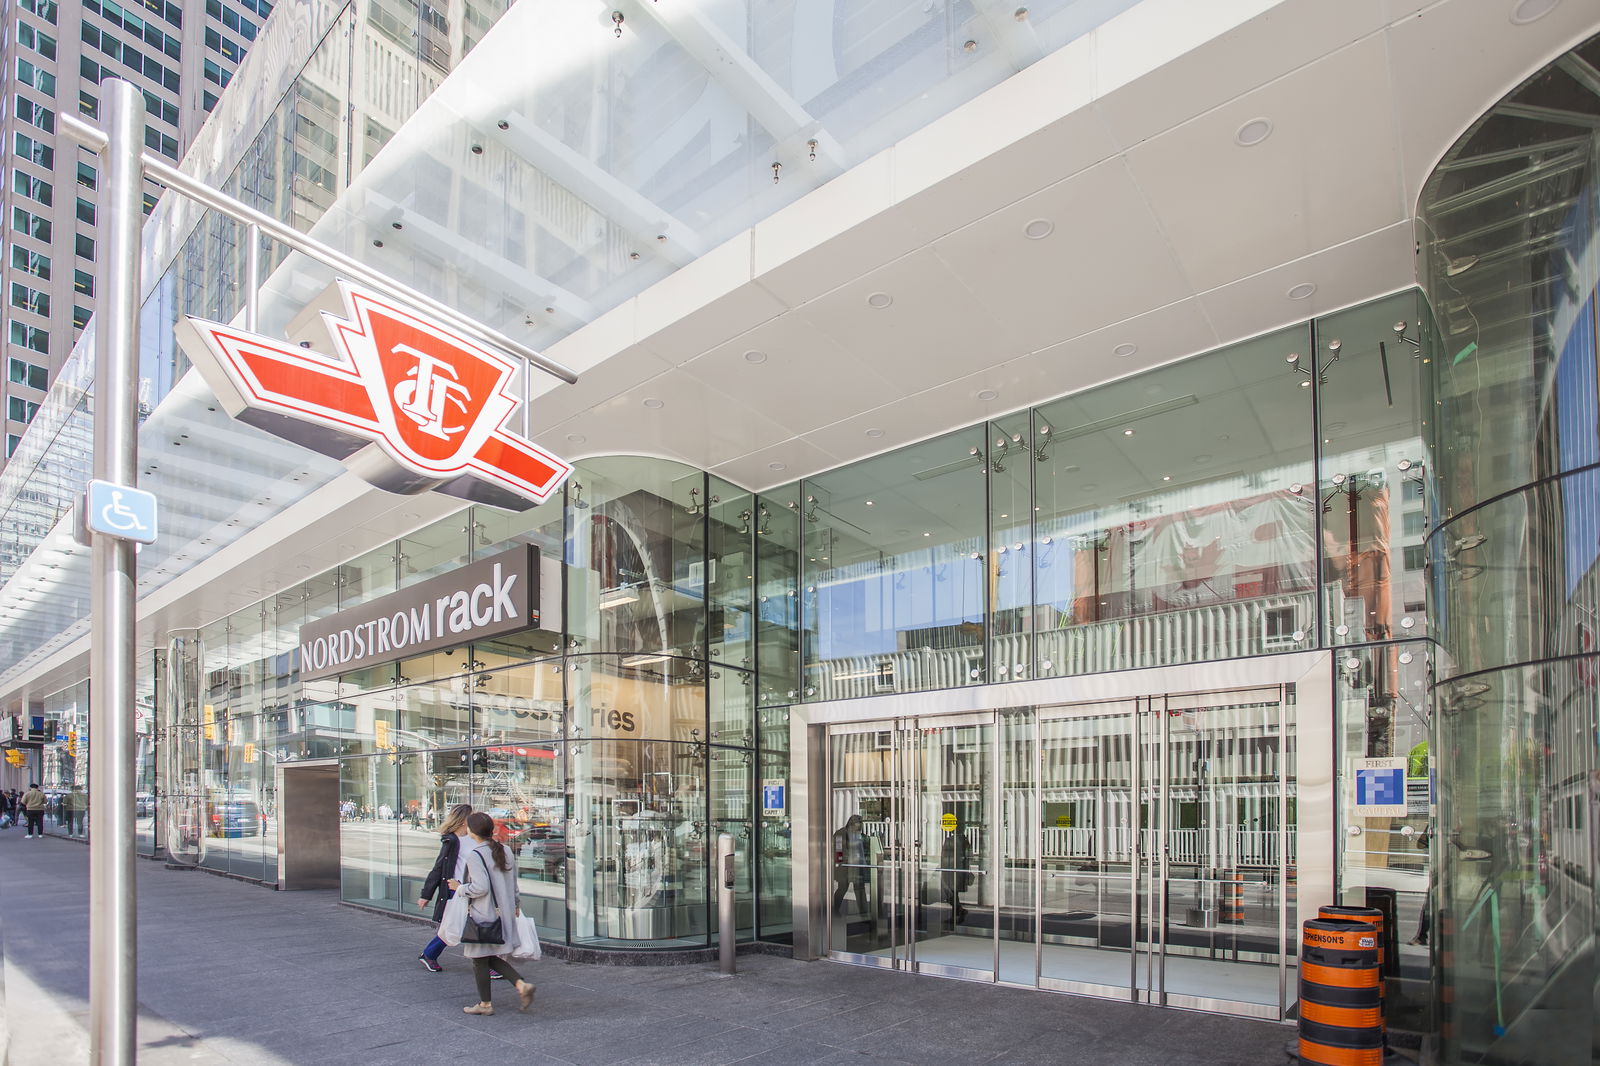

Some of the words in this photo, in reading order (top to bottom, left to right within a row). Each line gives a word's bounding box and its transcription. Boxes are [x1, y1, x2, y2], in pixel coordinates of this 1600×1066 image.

[301, 603, 431, 674] NORDSTROM
[436, 562, 518, 638] rack
[1365, 760, 1393, 768] FIRST
